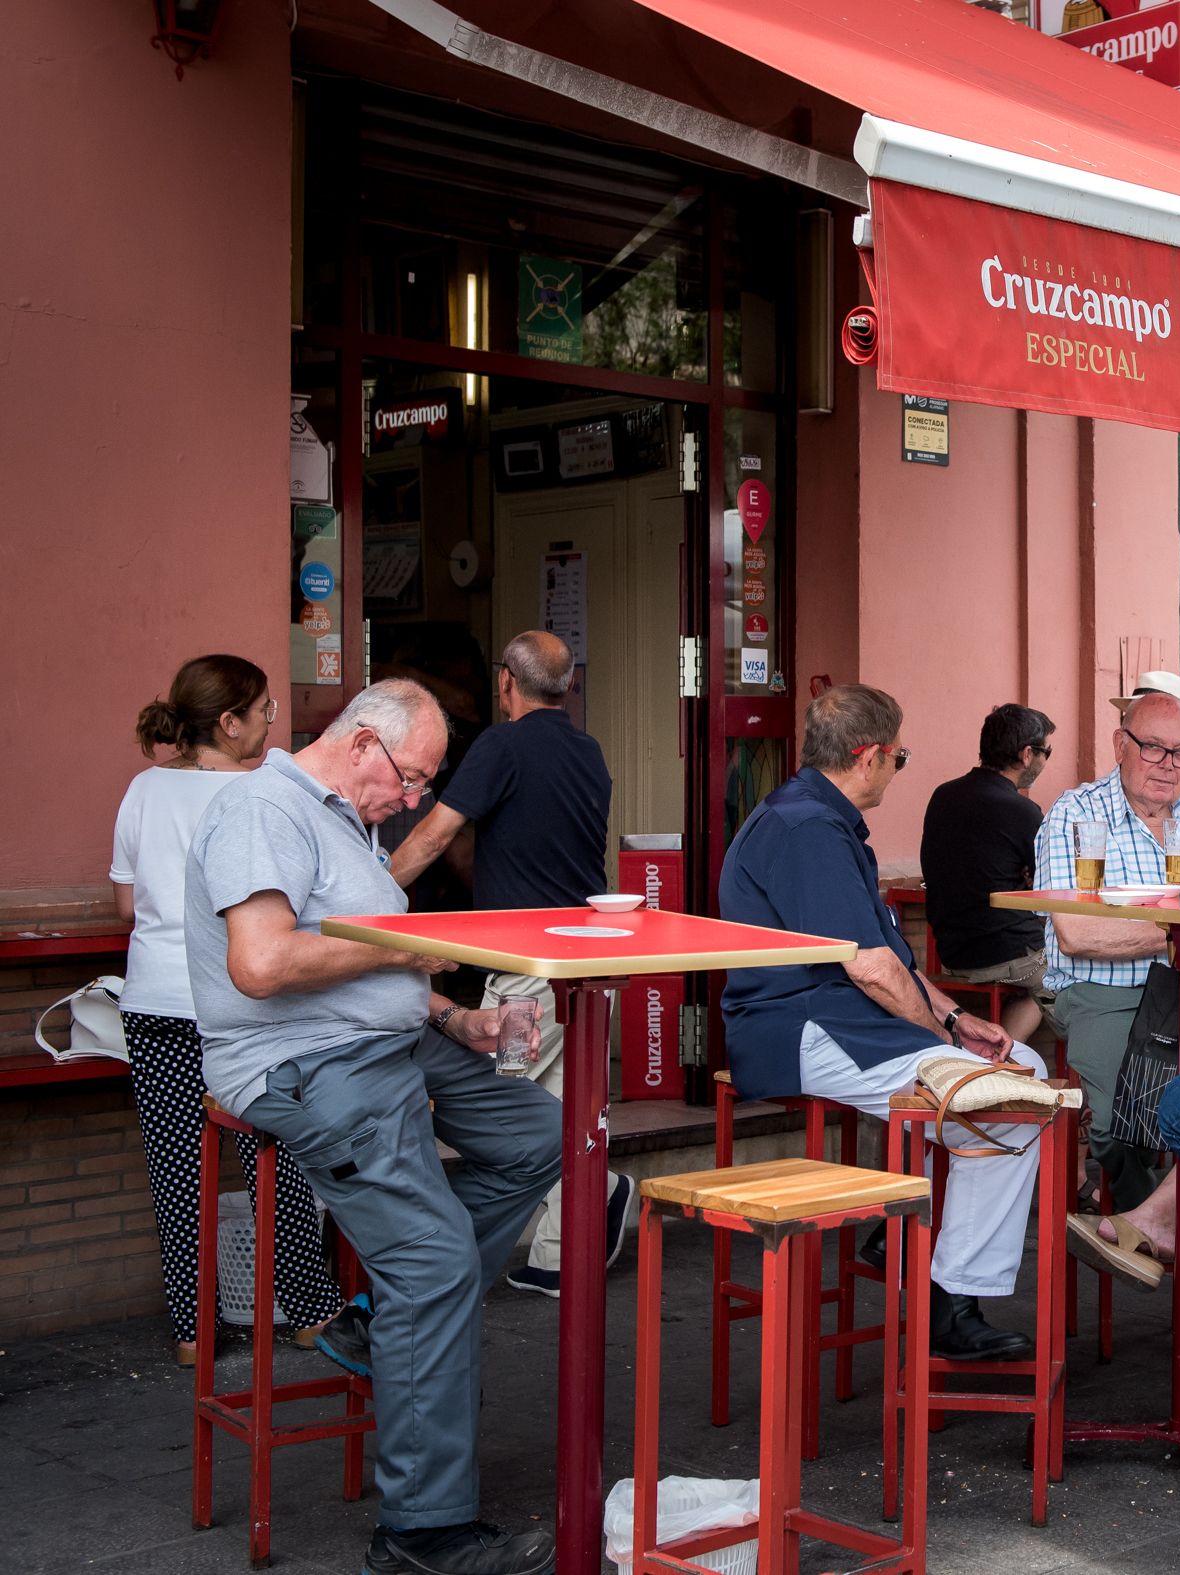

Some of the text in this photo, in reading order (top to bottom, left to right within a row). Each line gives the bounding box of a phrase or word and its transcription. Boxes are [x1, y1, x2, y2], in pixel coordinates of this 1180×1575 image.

[981, 255, 1171, 342] Cruzcampo
[1026, 331, 1145, 382] ESPECIAL
[375, 402, 448, 430] Cruzcampo
[907, 416, 945, 428] CONECTADA
[745, 661, 766, 671] VISA
[645, 989, 664, 1087] Cruzcampo
